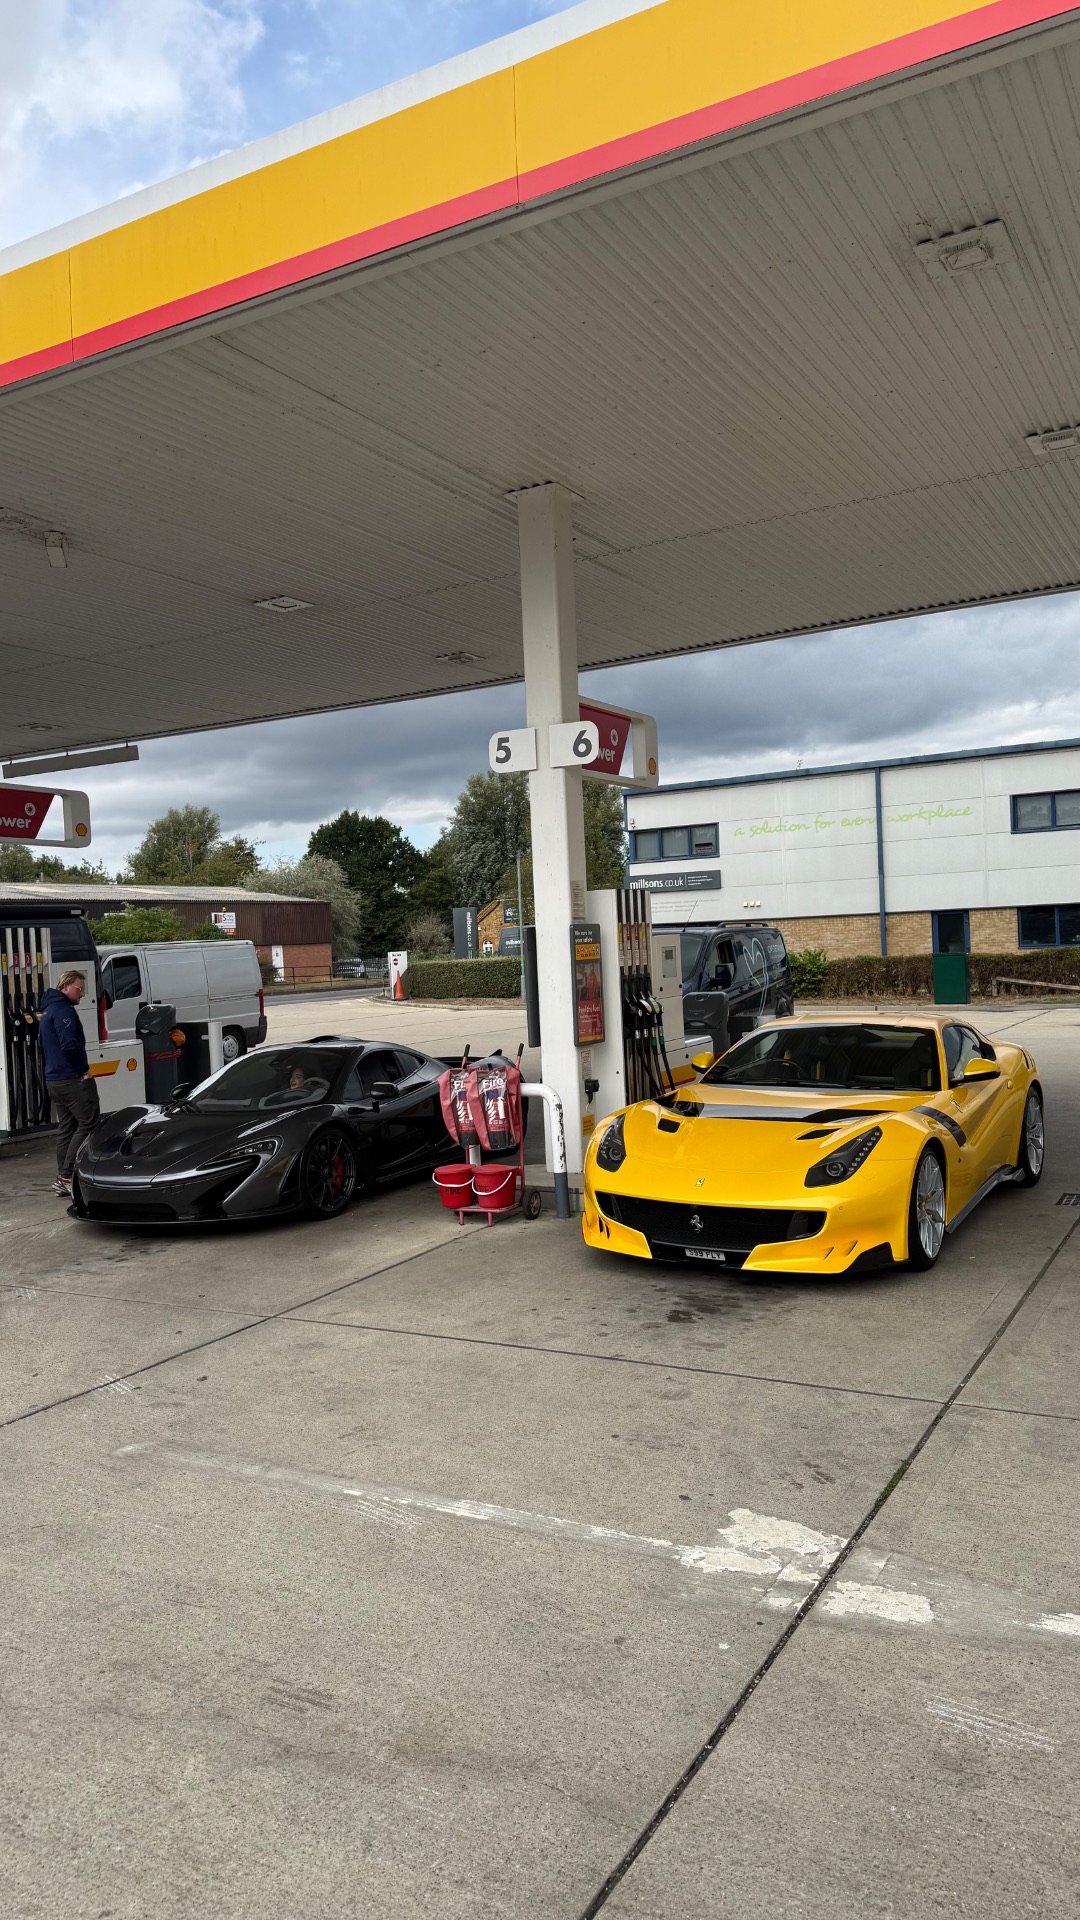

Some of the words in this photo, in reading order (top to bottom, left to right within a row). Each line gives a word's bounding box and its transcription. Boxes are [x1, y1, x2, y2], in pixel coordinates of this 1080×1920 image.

[495, 736, 512, 764] 5
[572, 729, 593, 758] 6
[0, 816, 32, 829] wer
[733, 827, 745, 836] a
[749, 817, 810, 838] solution
[814, 814, 835, 833] for
[886, 804, 973, 826] workplace
[629, 876, 684, 889] millsons.co.uk
[483, 1078, 503, 1088] Fire
[706, 1251, 720, 1259] FLY
